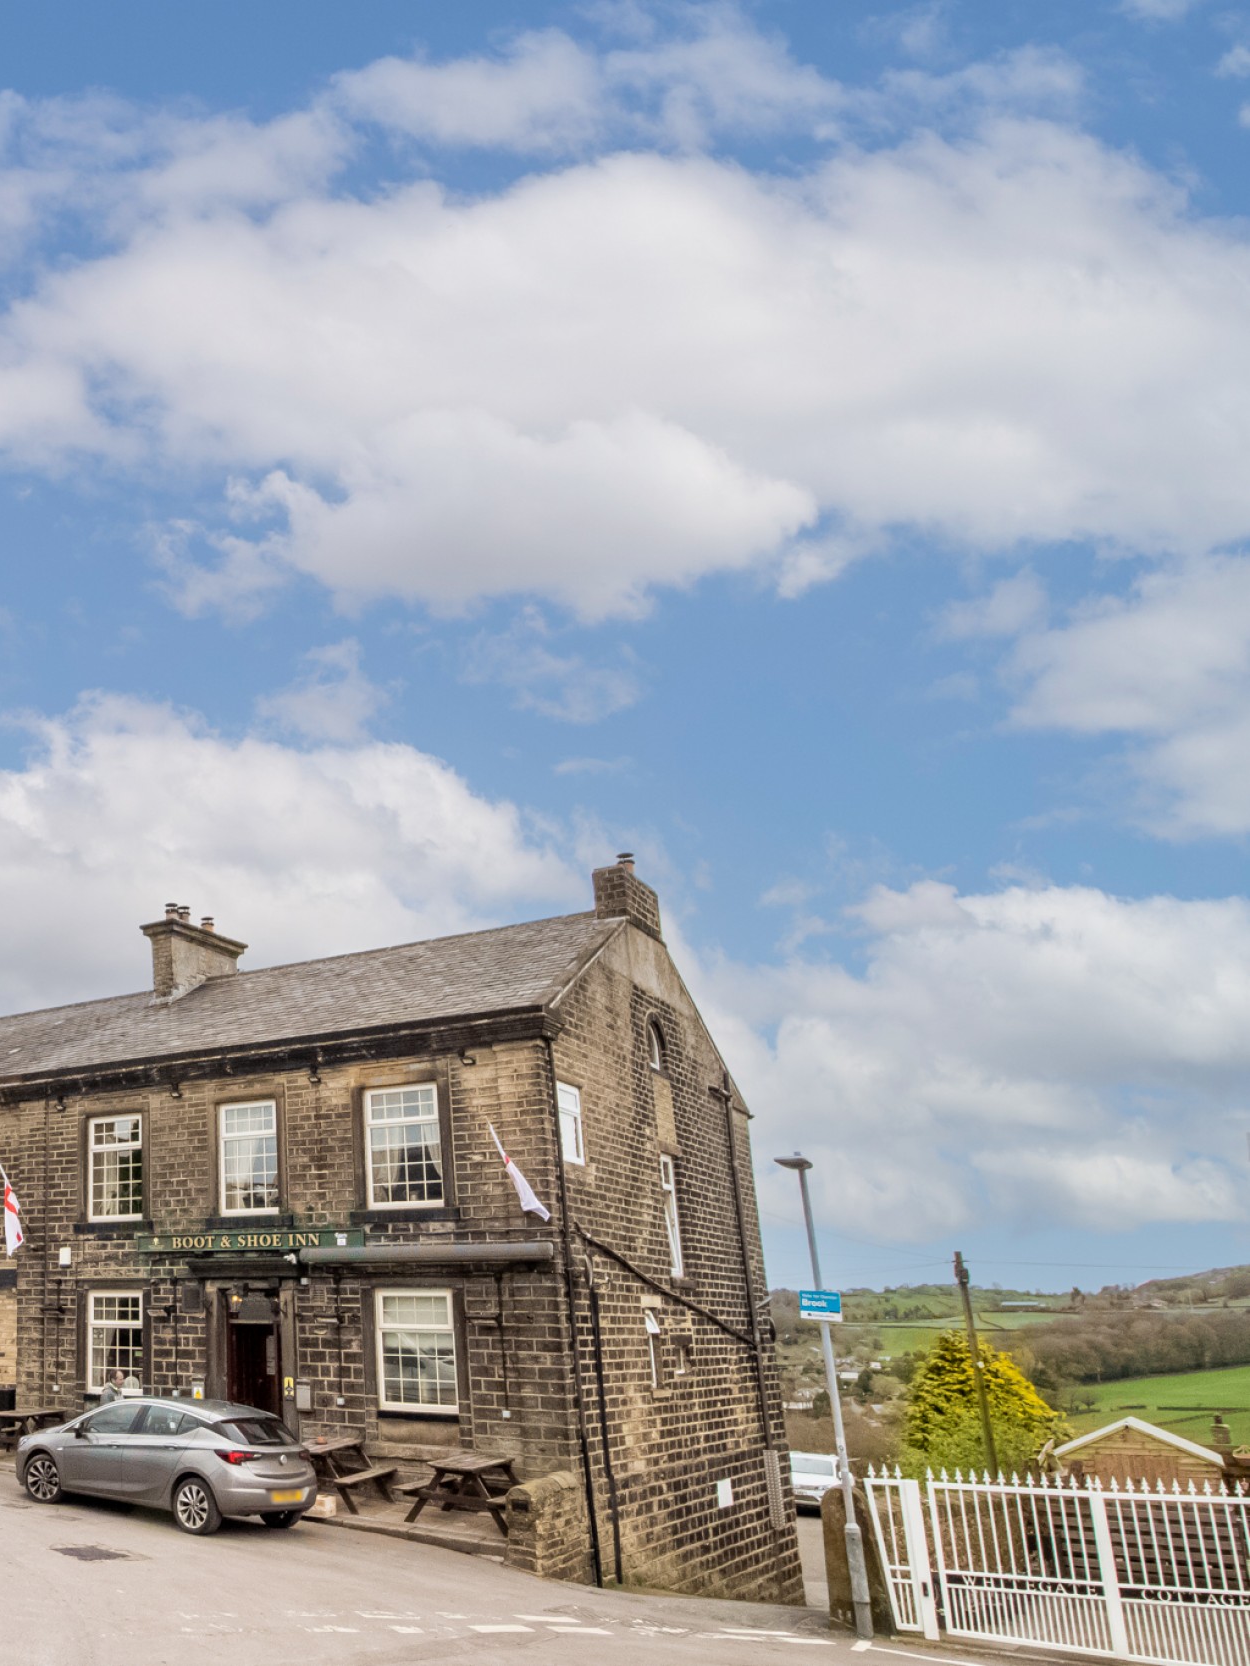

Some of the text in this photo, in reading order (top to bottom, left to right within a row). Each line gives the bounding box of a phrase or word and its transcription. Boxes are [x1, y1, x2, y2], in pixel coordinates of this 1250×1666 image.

[172, 1235, 215, 1249] BOOT
[220, 1235, 232, 1248] &
[237, 1233, 282, 1247] SHOE
[288, 1233, 320, 1246] INN
[801, 1298, 828, 1307] Brook
[961, 1573, 1250, 1606] WHITEGATE COTTAGE
